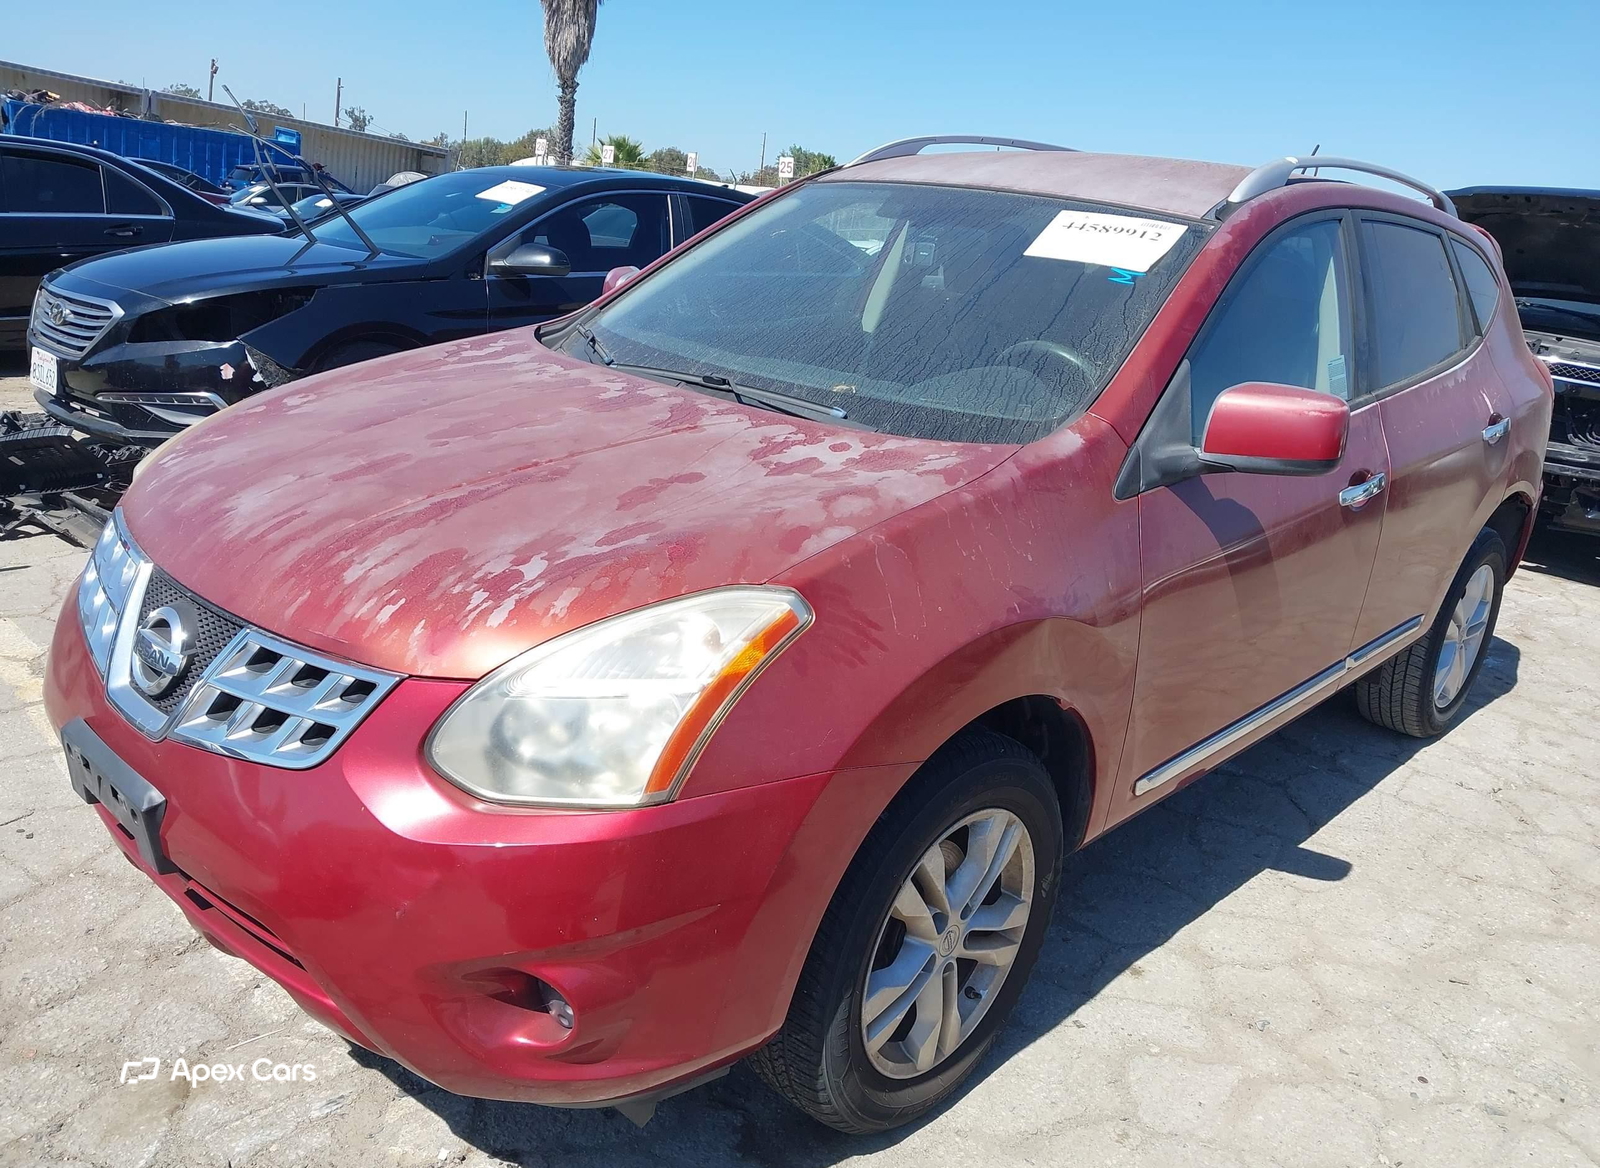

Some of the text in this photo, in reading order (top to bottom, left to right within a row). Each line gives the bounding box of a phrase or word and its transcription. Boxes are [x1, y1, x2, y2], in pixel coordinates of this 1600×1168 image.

[603, 149, 613, 160] 27
[780, 161, 793, 174] 25
[1062, 221, 1162, 241] 44589912
